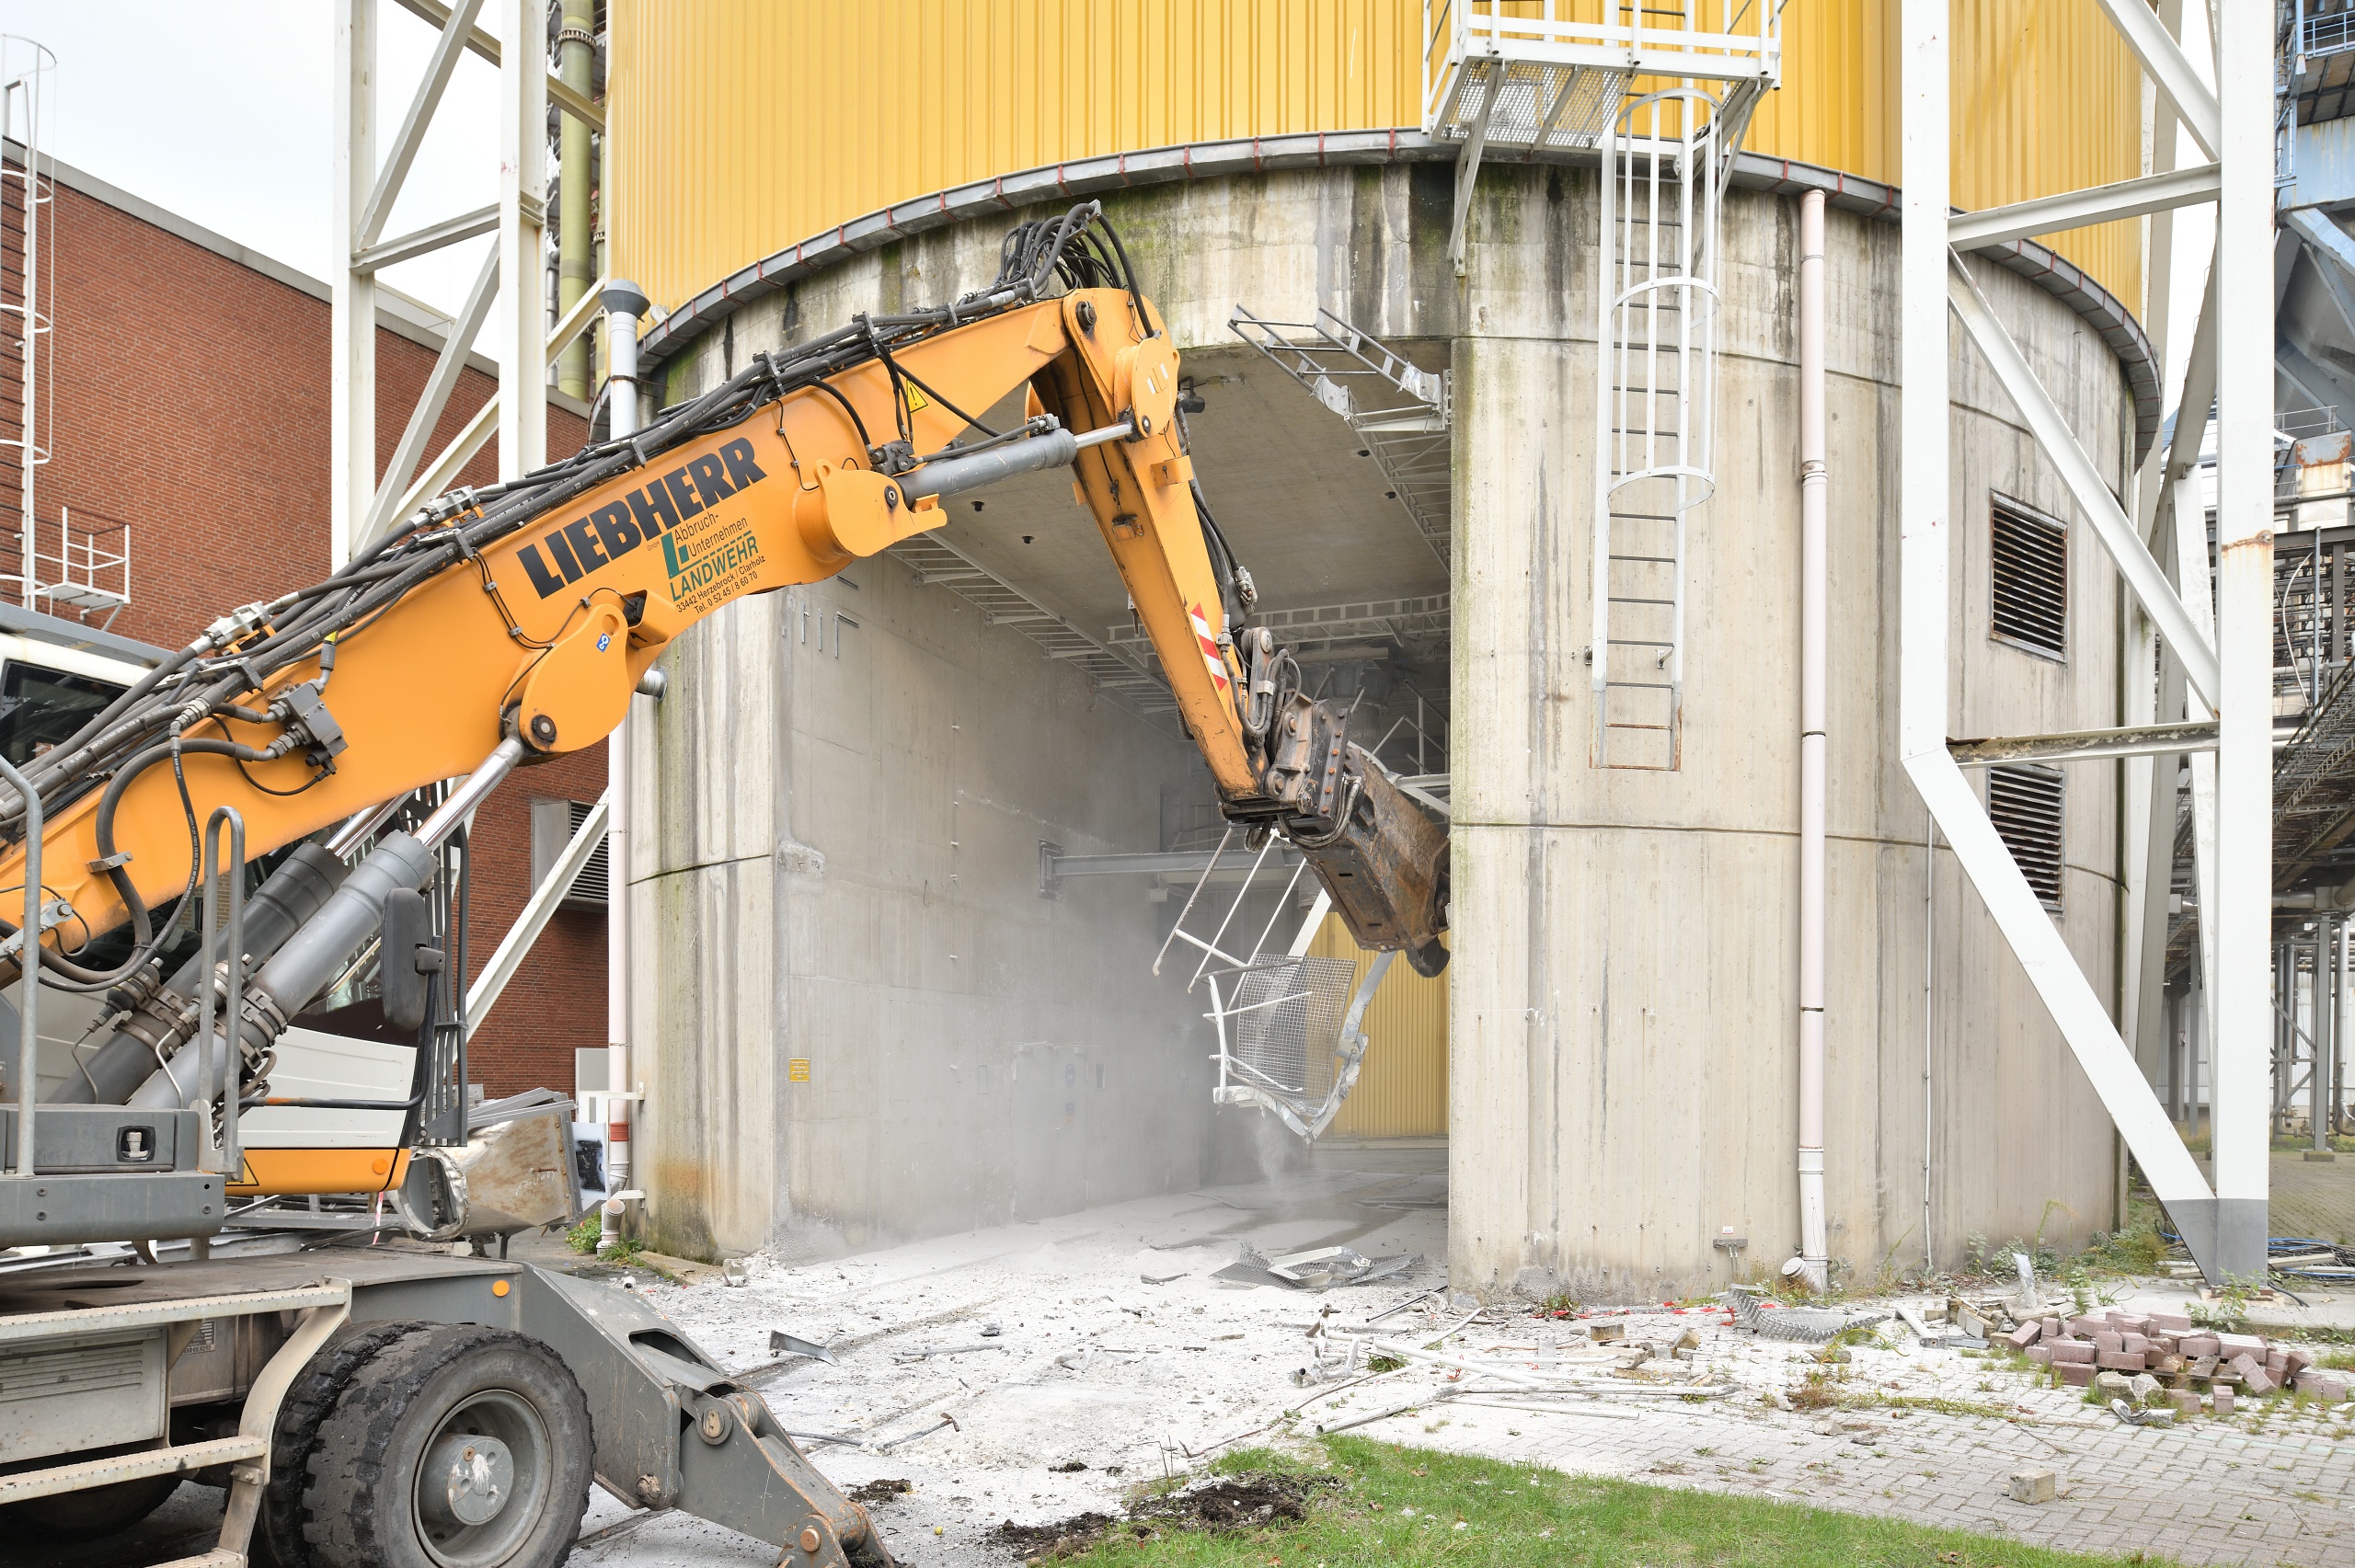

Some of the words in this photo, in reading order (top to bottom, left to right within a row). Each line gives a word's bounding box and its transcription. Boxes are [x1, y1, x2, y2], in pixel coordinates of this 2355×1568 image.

[516, 437, 767, 600] LIEBHERR
[674, 511, 719, 544] Abbruch-
[688, 517, 749, 557] Unternehmen
[647, 539, 661, 552] GmbH
[670, 536, 759, 602] LANDWEHR
[676, 595, 698, 613] 33442
[698, 573, 736, 601] Herzebrock
[739, 555, 766, 575] Clarholz
[694, 603, 708, 614] Tel.
[707, 598, 713, 607] 0
[713, 592, 722, 603] 52
[722, 588, 731, 599] 45
[734, 581, 741, 590] 8
[740, 576, 749, 588] 60
[749, 571, 758, 581] 70
